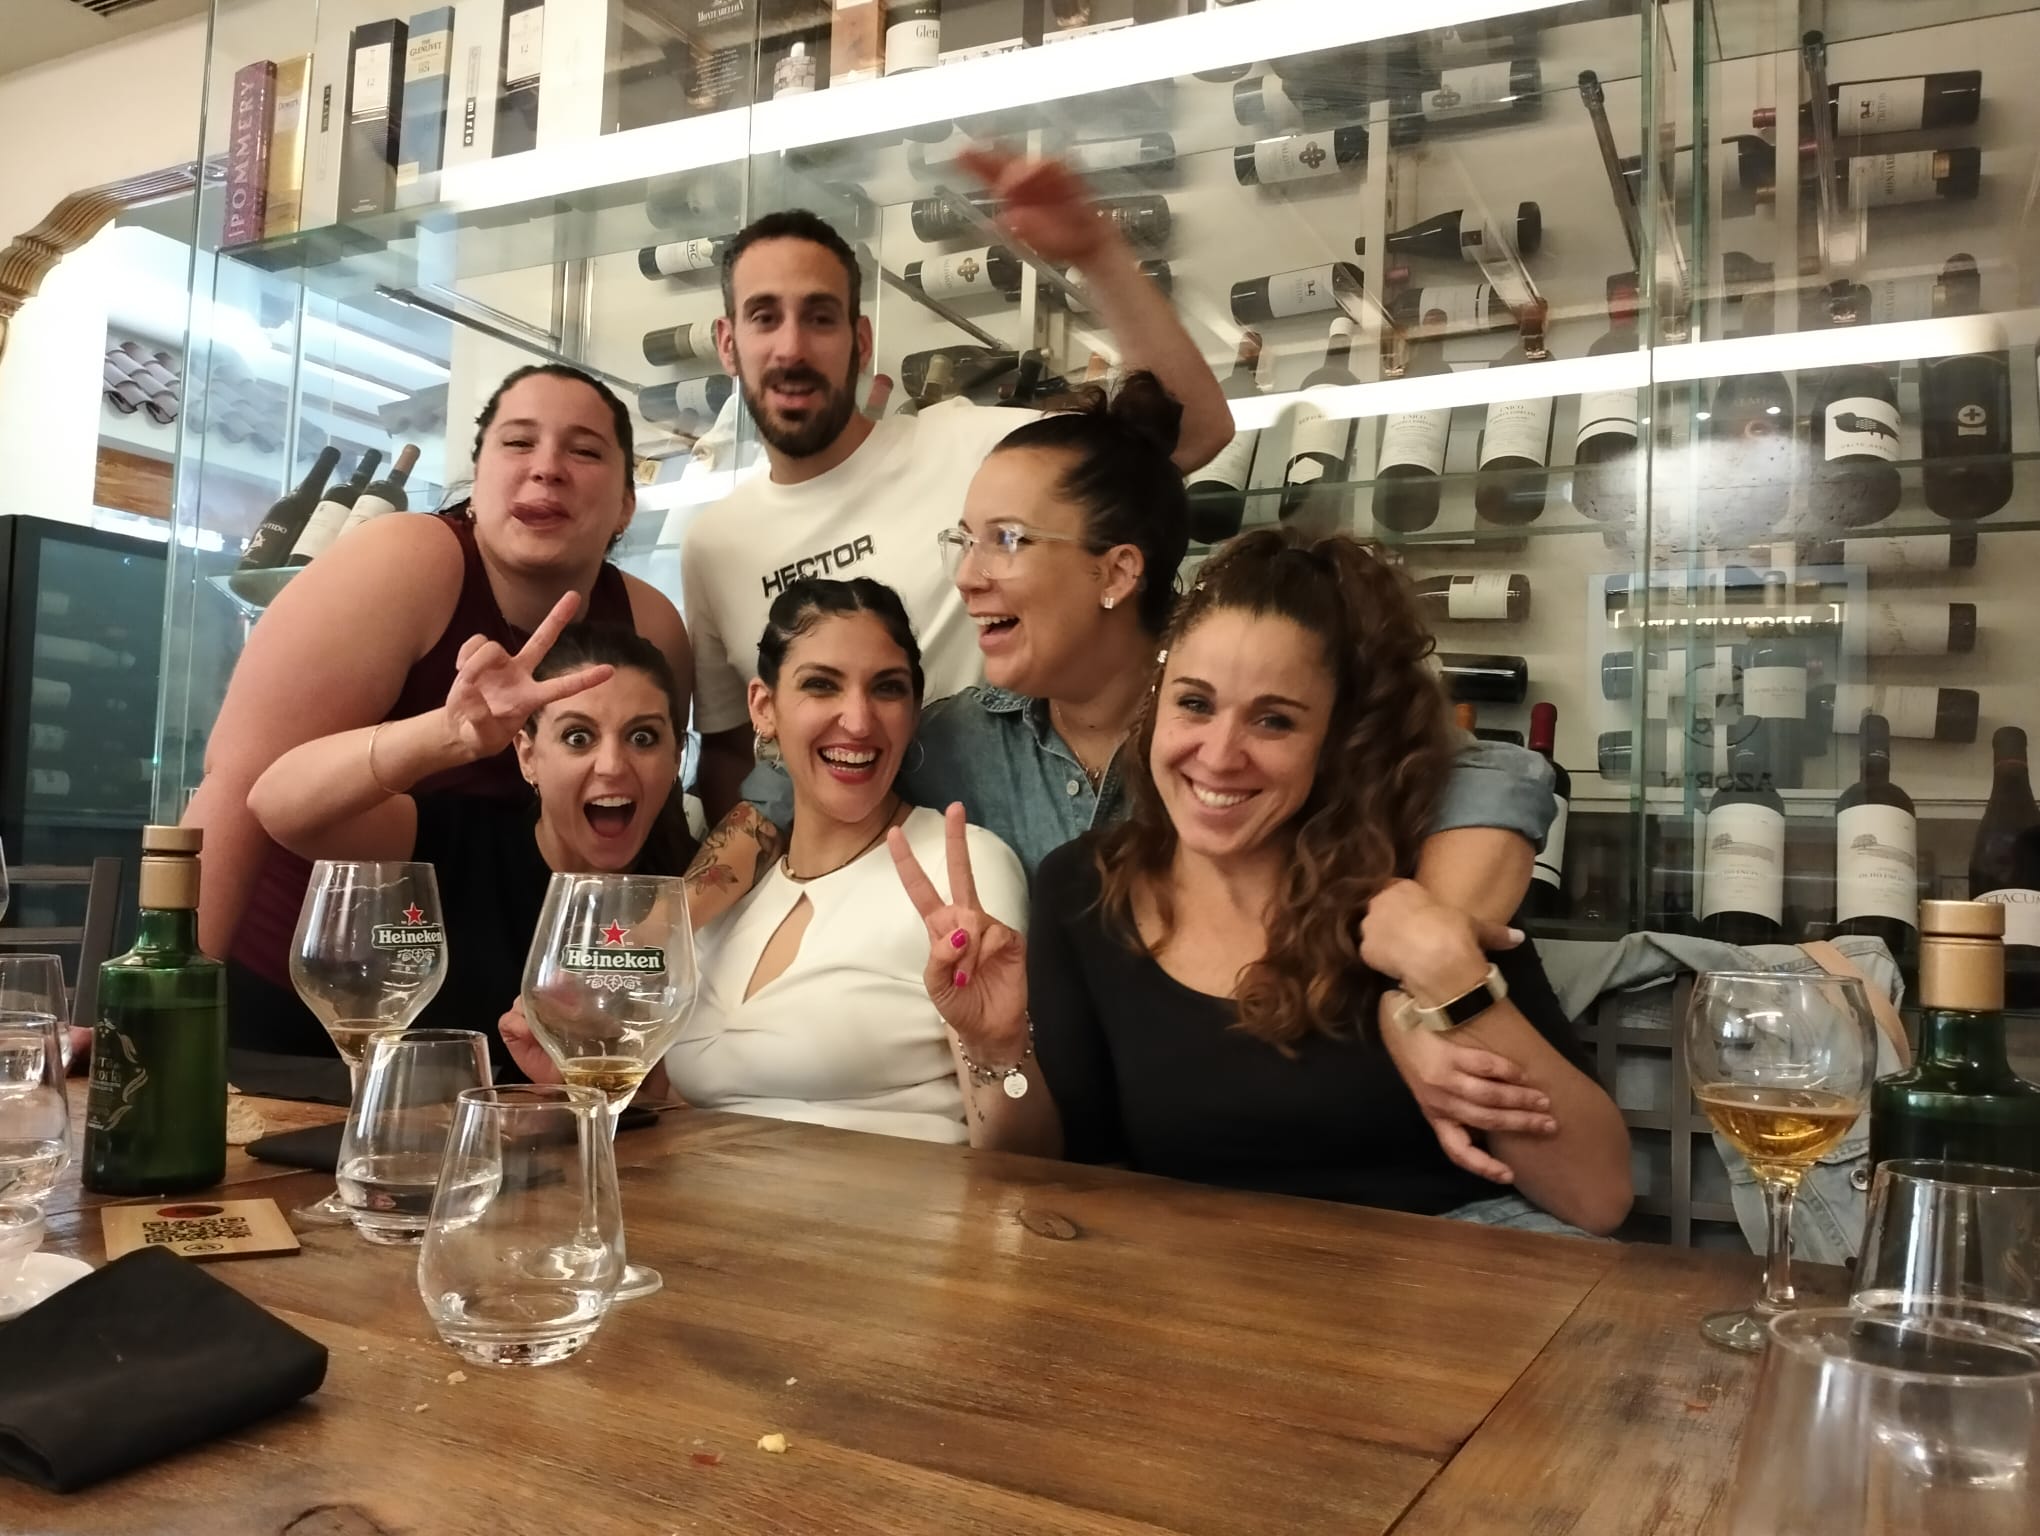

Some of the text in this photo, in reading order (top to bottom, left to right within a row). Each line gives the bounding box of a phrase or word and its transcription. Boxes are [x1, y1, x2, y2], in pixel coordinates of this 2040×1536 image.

[231, 81, 255, 228] POMMERY
[761, 534, 875, 598] HECTOR
[379, 929, 443, 945] Heineken
[566, 950, 661, 969] Heineken
